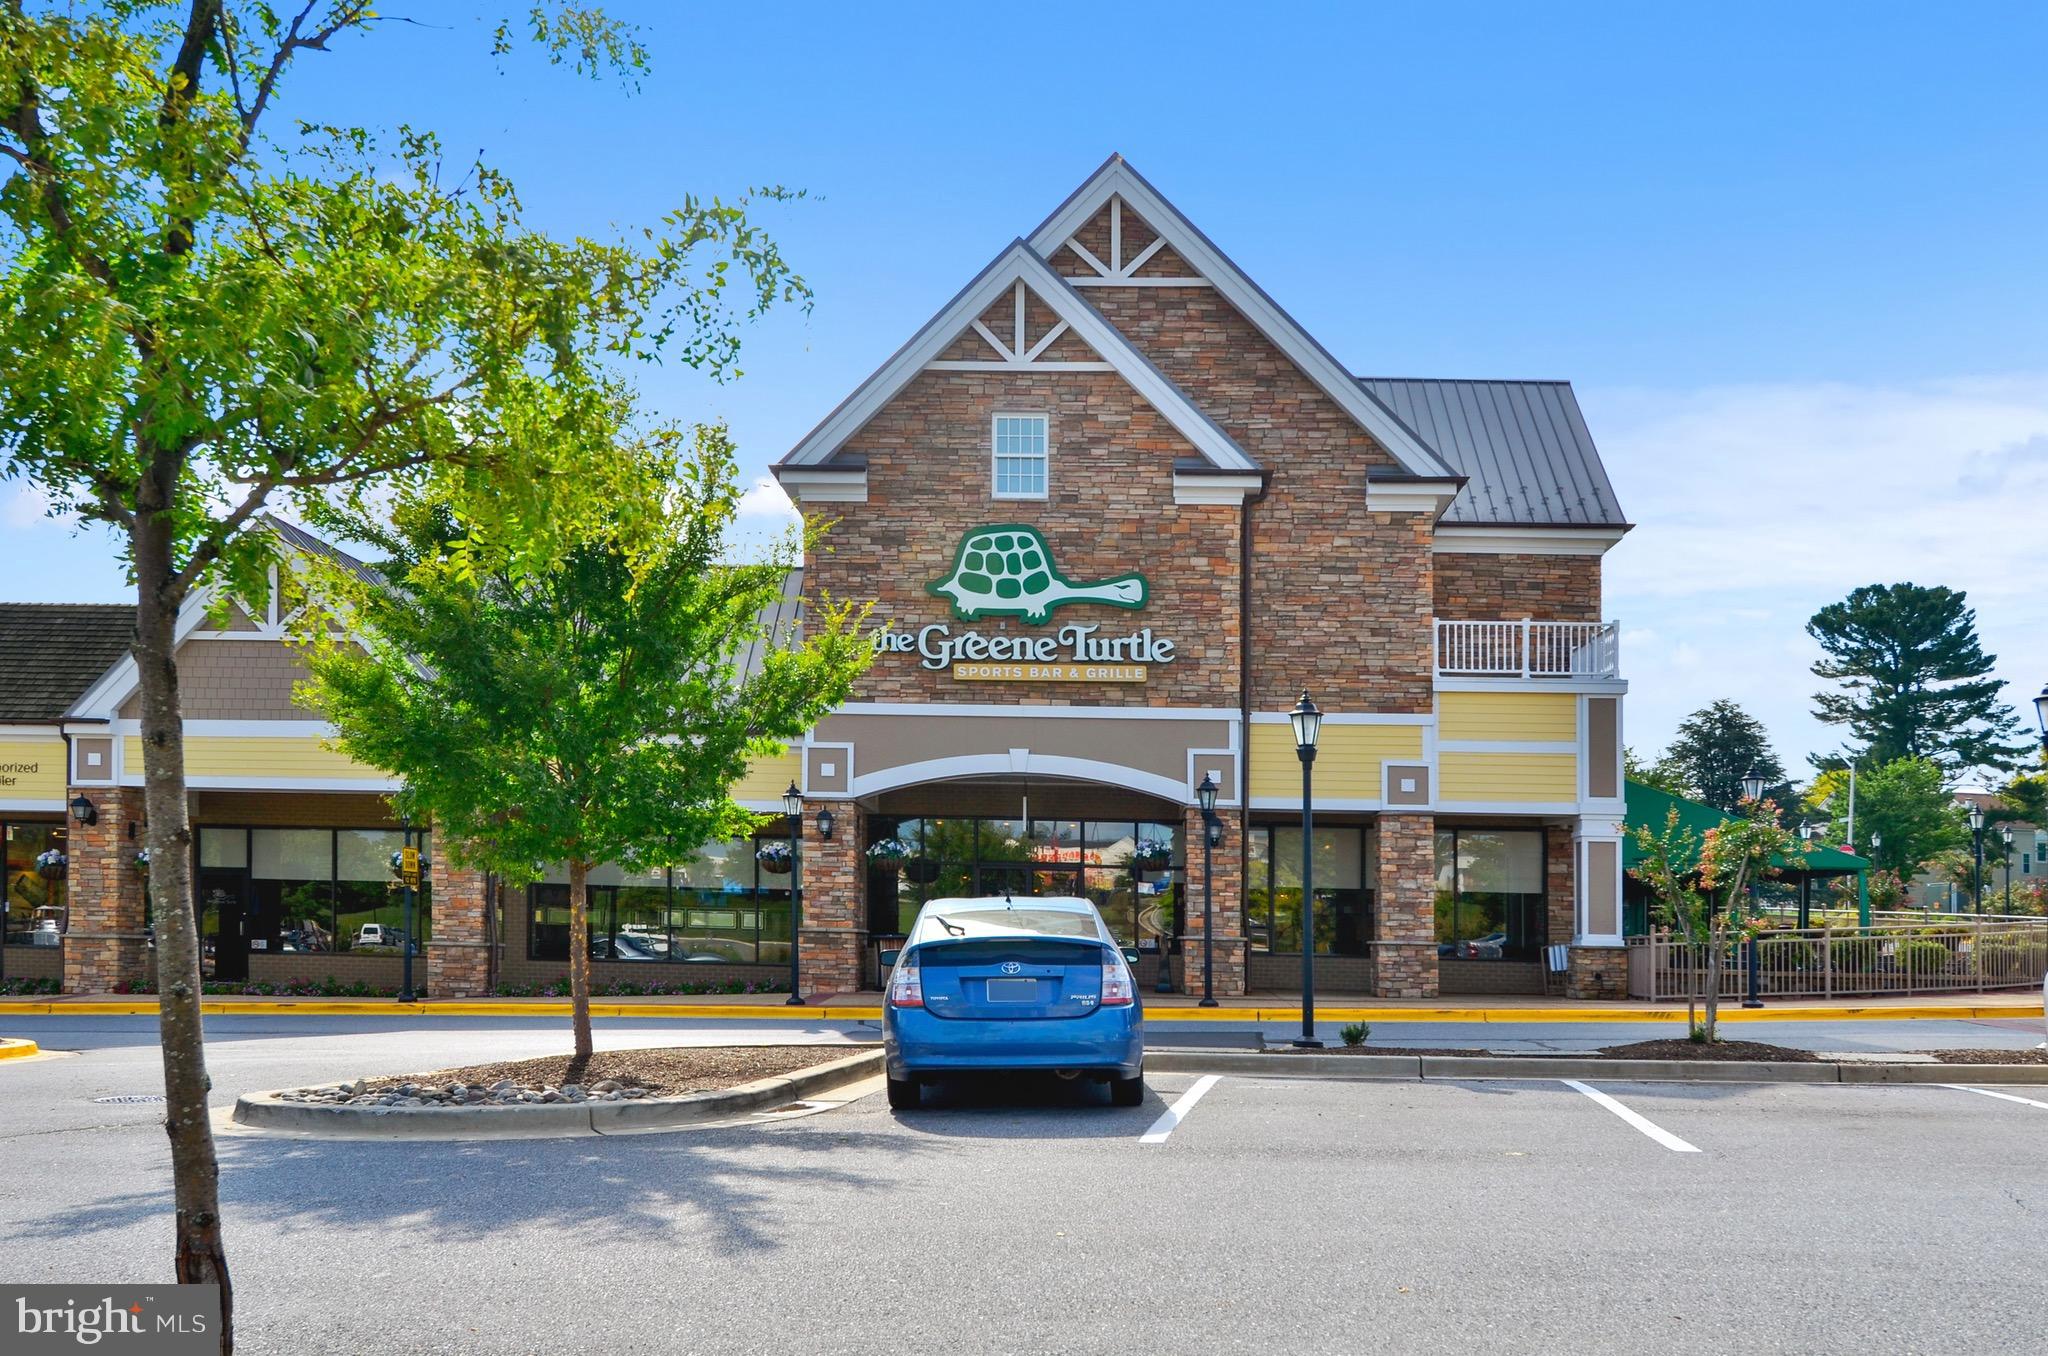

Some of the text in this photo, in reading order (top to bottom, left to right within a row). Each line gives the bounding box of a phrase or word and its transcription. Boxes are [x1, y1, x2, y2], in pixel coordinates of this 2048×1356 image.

[917, 624, 1057, 670] Greene
[1058, 624, 1176, 663] Turtle
[957, 666, 1144, 680] SPORTS BAR & GRILLE
[0, 762, 38, 773] orized
